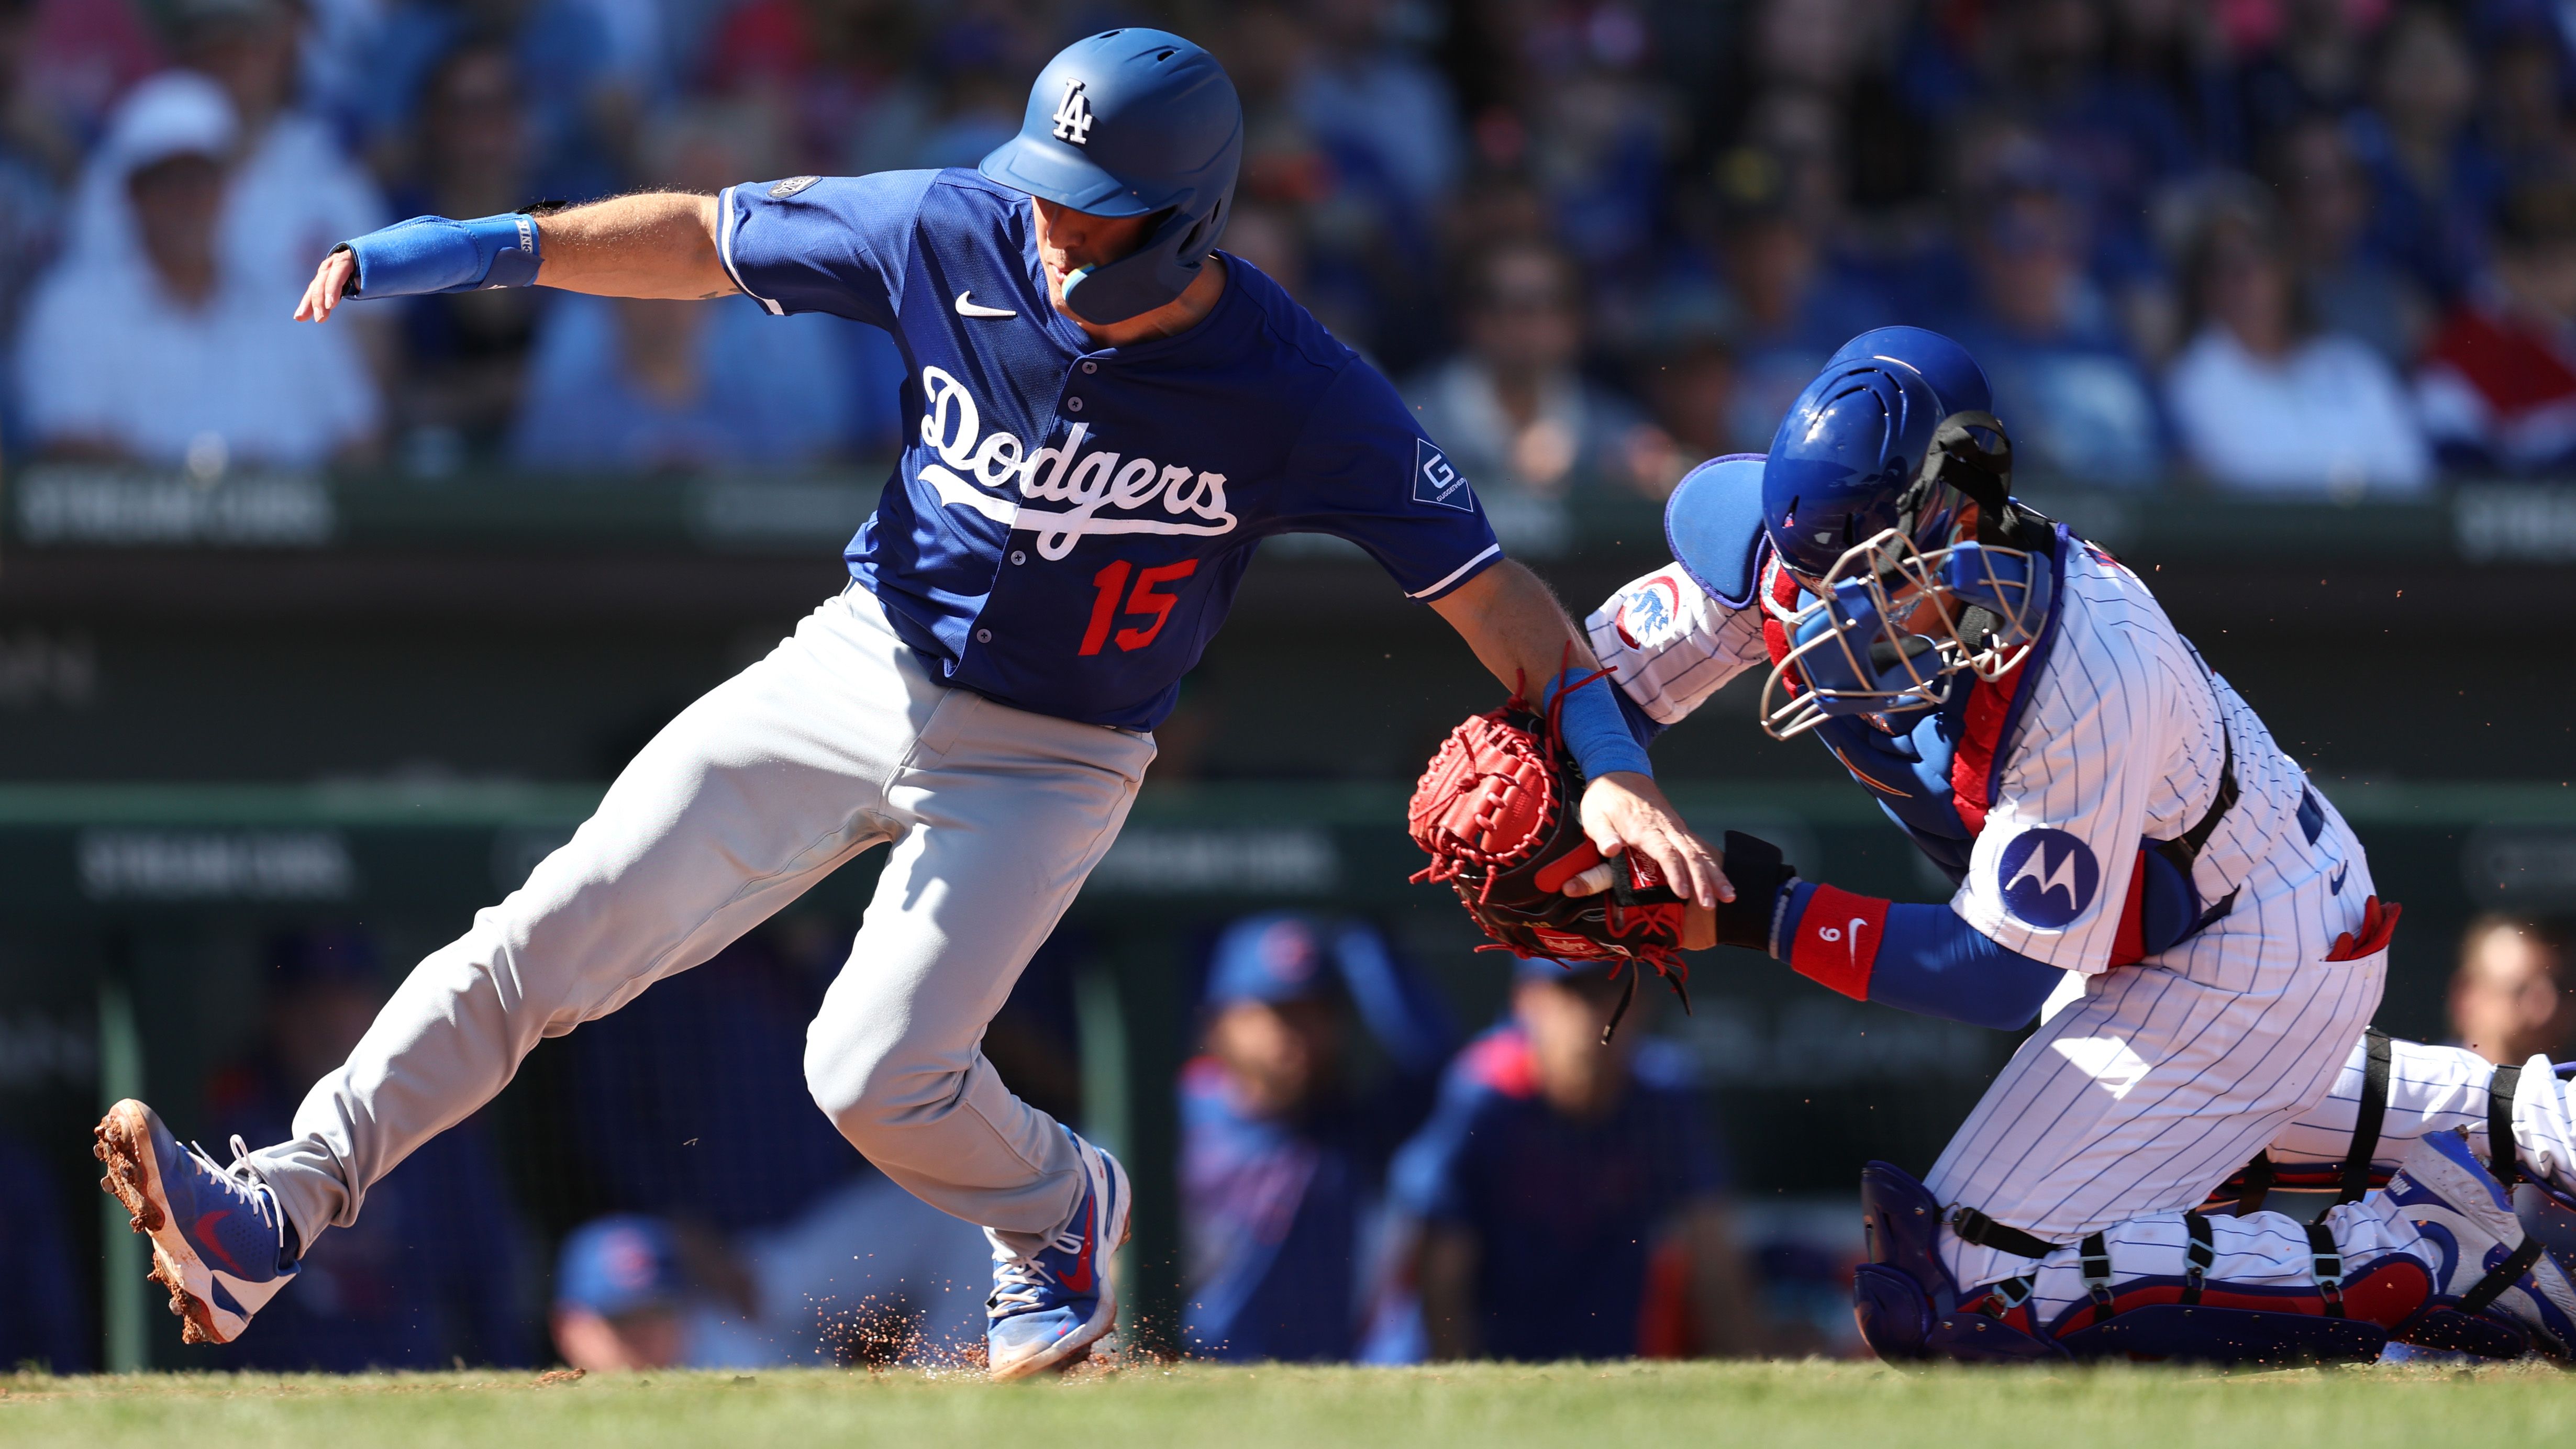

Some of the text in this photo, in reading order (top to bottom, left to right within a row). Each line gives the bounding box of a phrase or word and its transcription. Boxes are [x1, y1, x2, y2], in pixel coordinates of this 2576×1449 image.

[1053, 77, 1092, 144] LA
[918, 365, 1237, 561] Dodgers
[1424, 453, 1454, 488] G
[1078, 559, 1198, 655] 15
